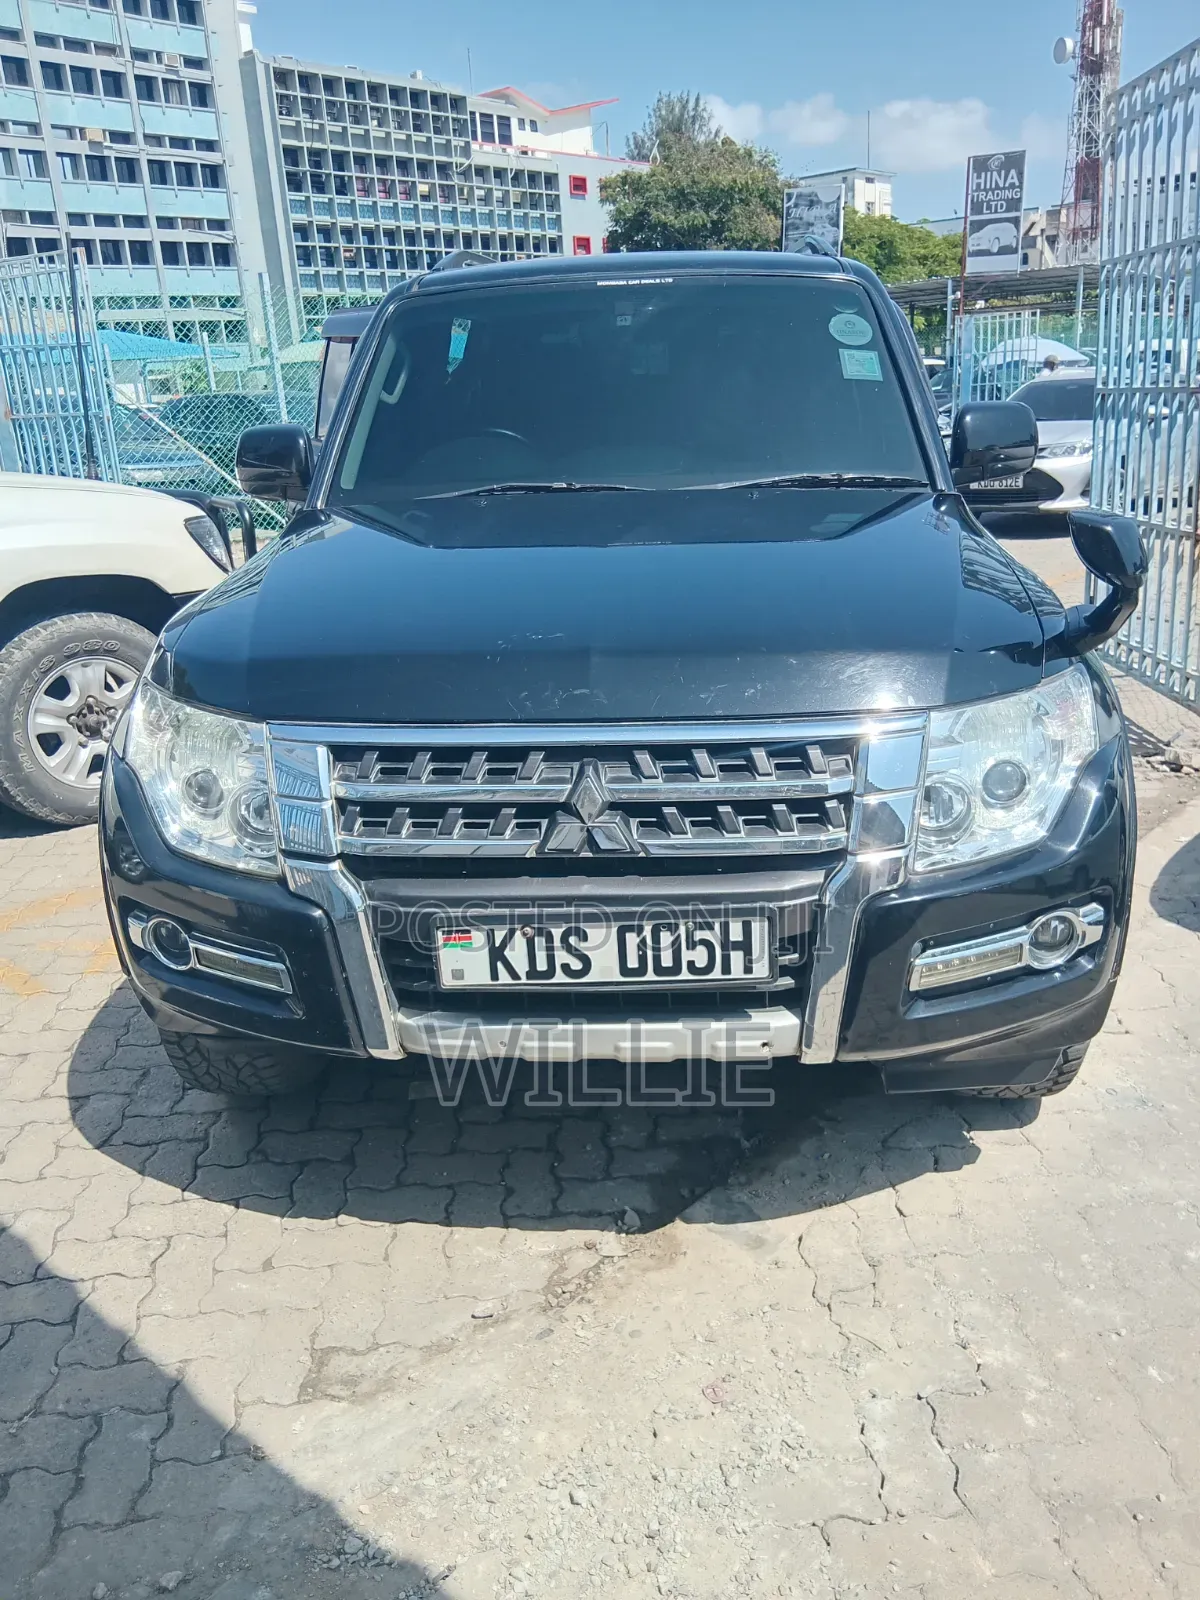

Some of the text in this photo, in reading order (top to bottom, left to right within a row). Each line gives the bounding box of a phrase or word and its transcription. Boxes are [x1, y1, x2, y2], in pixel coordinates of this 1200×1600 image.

[972, 168, 1020, 191] HINA
[972, 188, 1021, 203] TRADING
[983, 200, 1007, 214] LTD
[13, 639, 120, 774] MAXXIS 980
[486, 925, 593, 982] KDS
[616, 919, 754, 978] 005H
